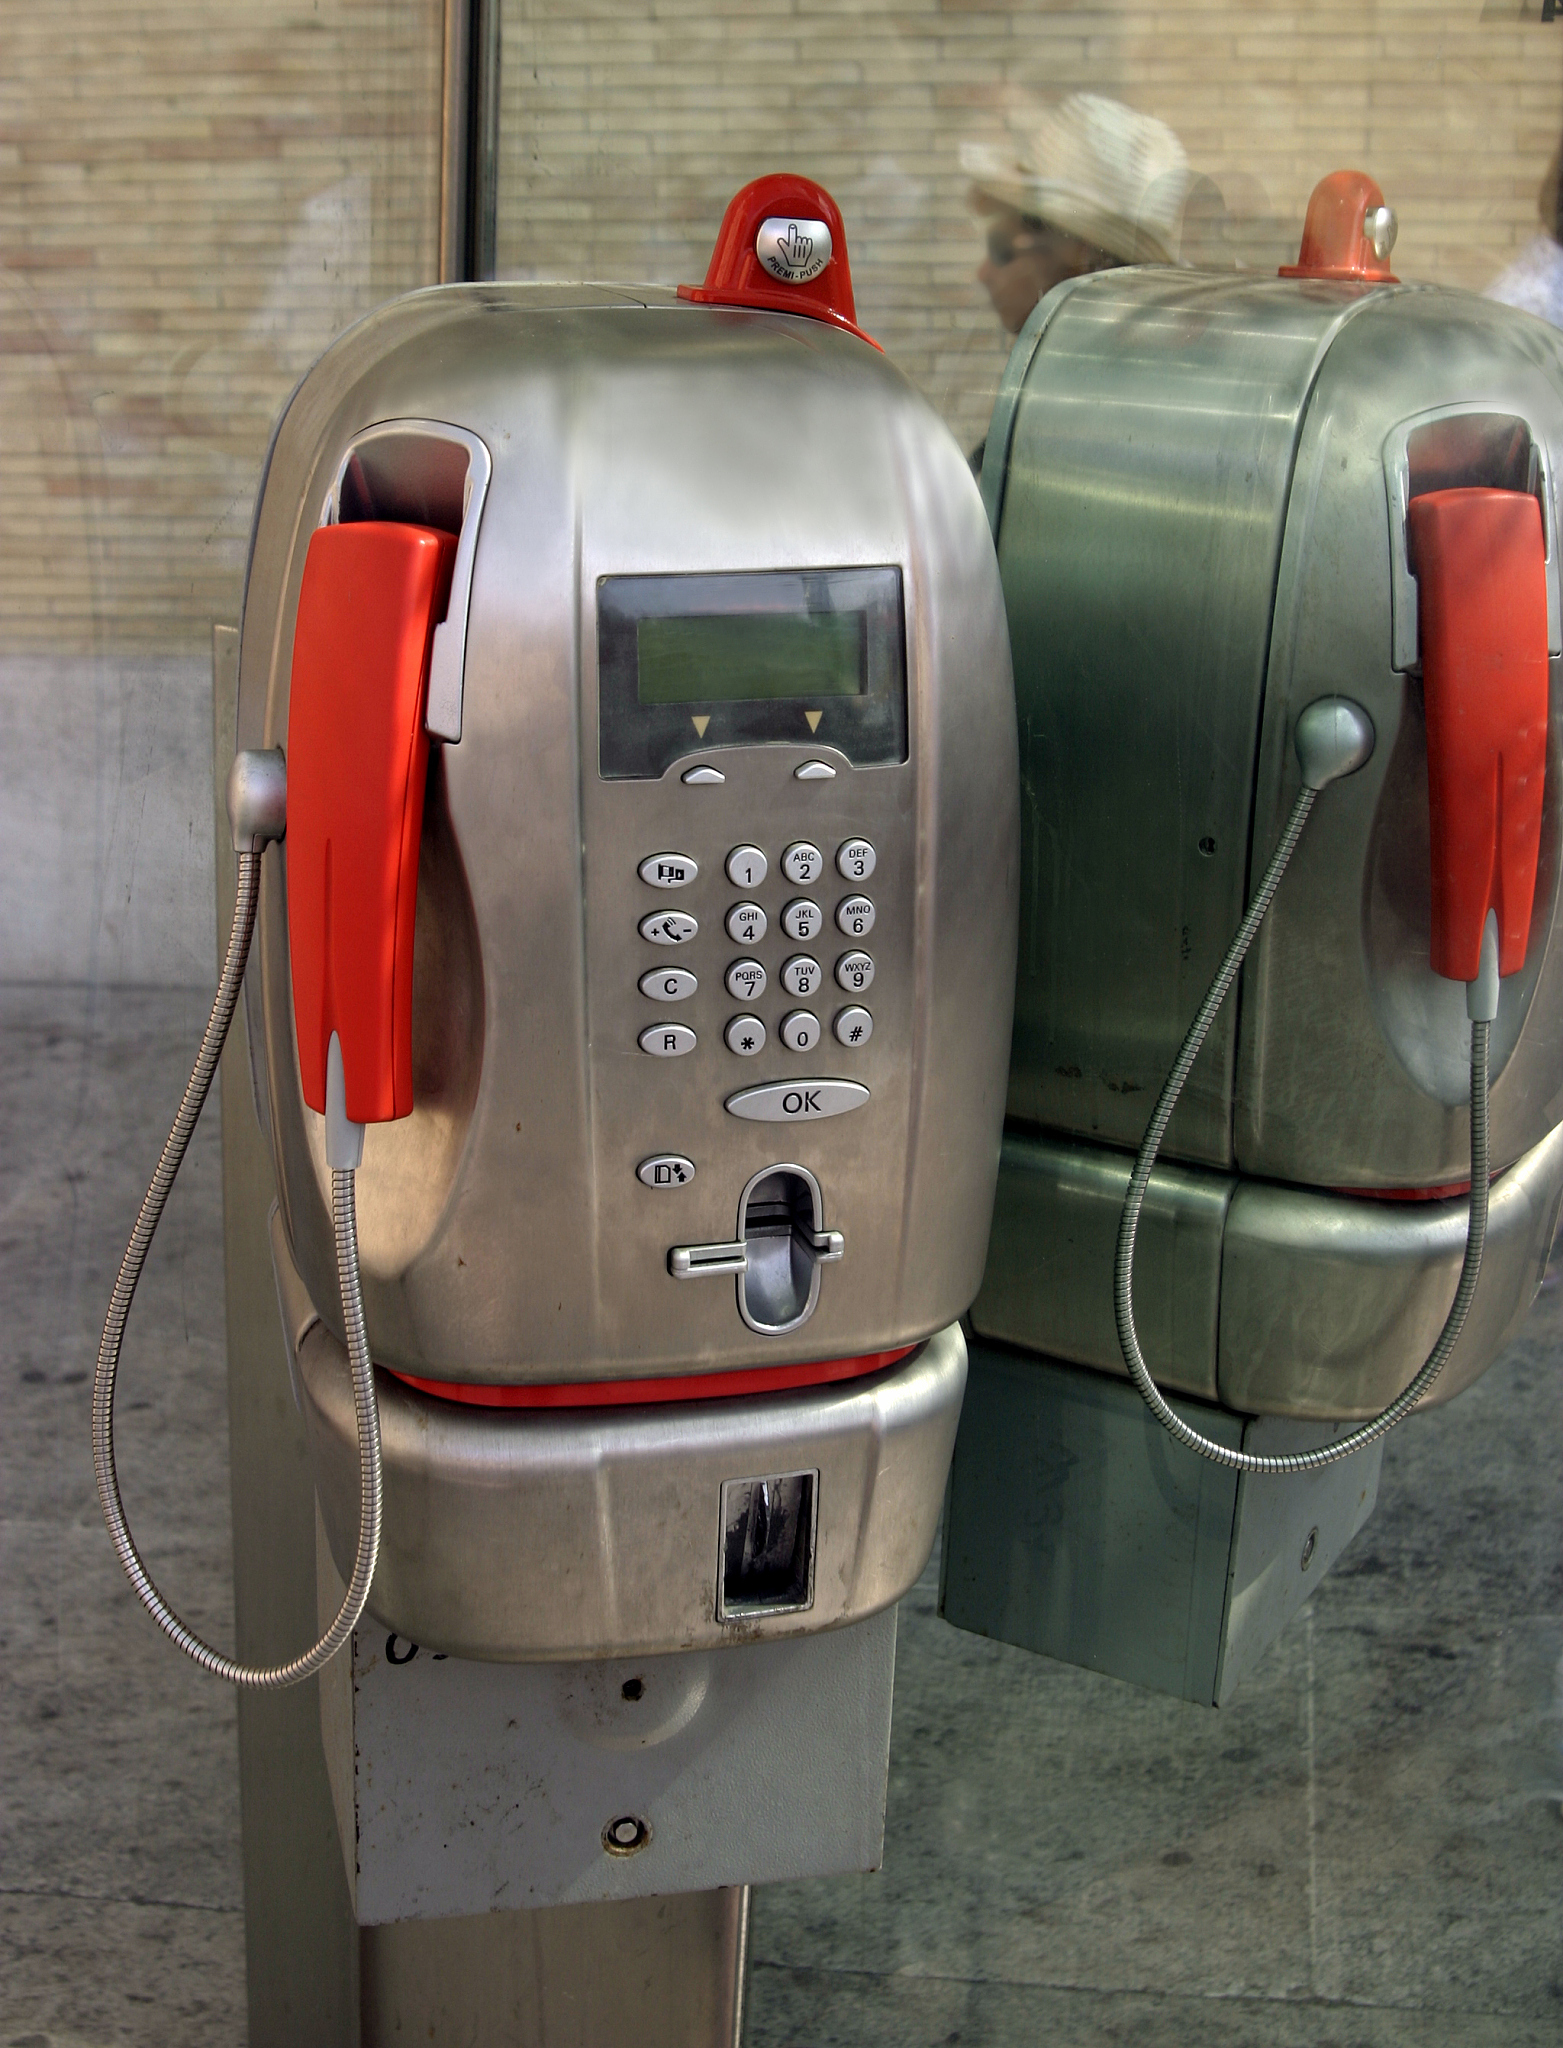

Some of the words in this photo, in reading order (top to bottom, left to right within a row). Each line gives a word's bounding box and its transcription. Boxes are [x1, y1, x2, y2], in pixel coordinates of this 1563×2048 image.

[793, 852, 815, 862] ABC
[848, 849, 869, 858] DEF
[744, 868, 752, 884] 1
[799, 864, 811, 880] 2
[853, 861, 865, 876] 3
[795, 909, 815, 919] JKL
[846, 905, 871, 915] MNO
[739, 911, 758, 921] GHI
[742, 925, 755, 940] 4
[798, 922, 810, 937] 5
[852, 918, 864, 933] 6
[794, 966, 815, 976] TUV
[844, 962, 872, 973] WXYZ
[735, 970, 763, 982] PQRS
[663, 978, 678, 995] C
[744, 982, 756, 997] 7
[798, 978, 810, 993] 8
[852, 972, 864, 987] 9
[663, 1034, 677, 1050] R
[782, 1090, 822, 1114] OK
